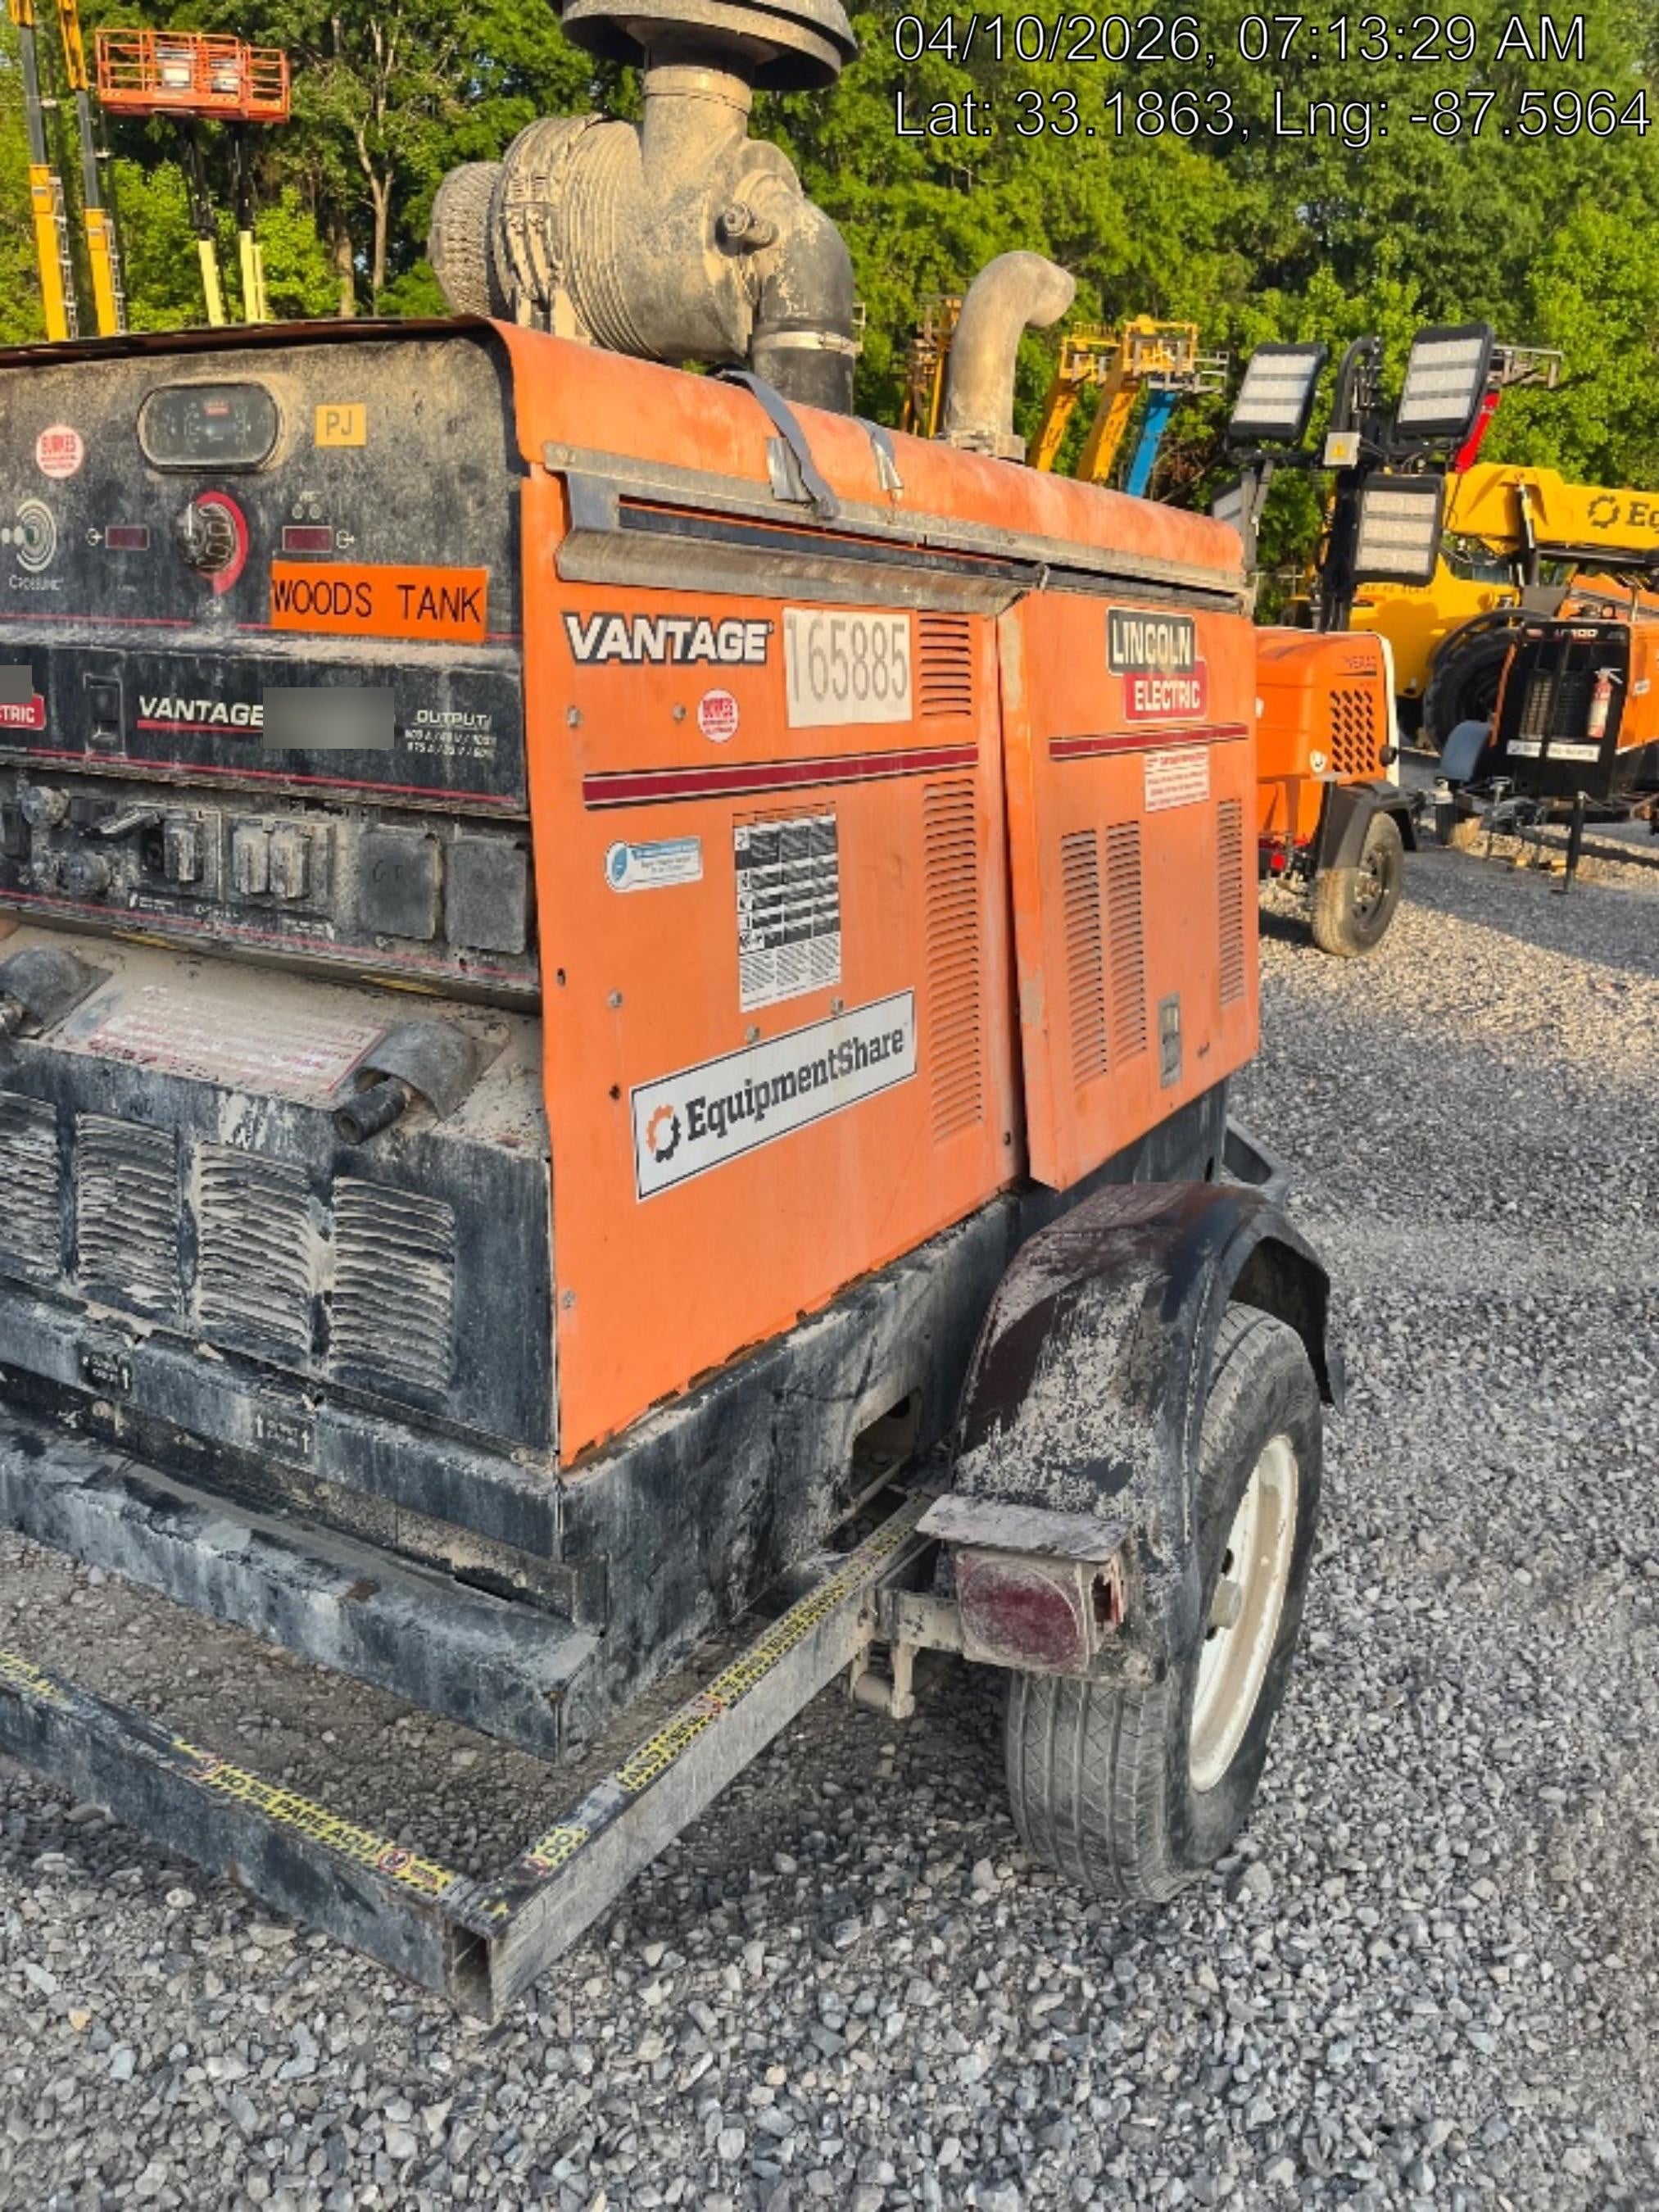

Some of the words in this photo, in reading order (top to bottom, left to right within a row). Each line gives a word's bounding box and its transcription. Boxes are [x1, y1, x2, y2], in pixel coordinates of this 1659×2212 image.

[325, 410, 352, 437] PJ
[272, 578, 372, 617] WOODS
[397, 583, 482, 623] TANK
[563, 613, 772, 664] VANTAGE
[1113, 619, 1190, 665] LINCOLN
[786, 614, 908, 704] 165885
[0, 705, 35, 723] TRIC
[138, 696, 263, 726] VANTAGE
[1134, 679, 1200, 711] ELECTRIC
[417, 709, 487, 726] OUTPUT
[685, 1027, 905, 1141] EquipmentShare
[216, 1766, 247, 1790] NO
[247, 1783, 274, 1803] SE
[273, 1797, 329, 1830] PARE
[542, 1832, 573, 1858] DO
